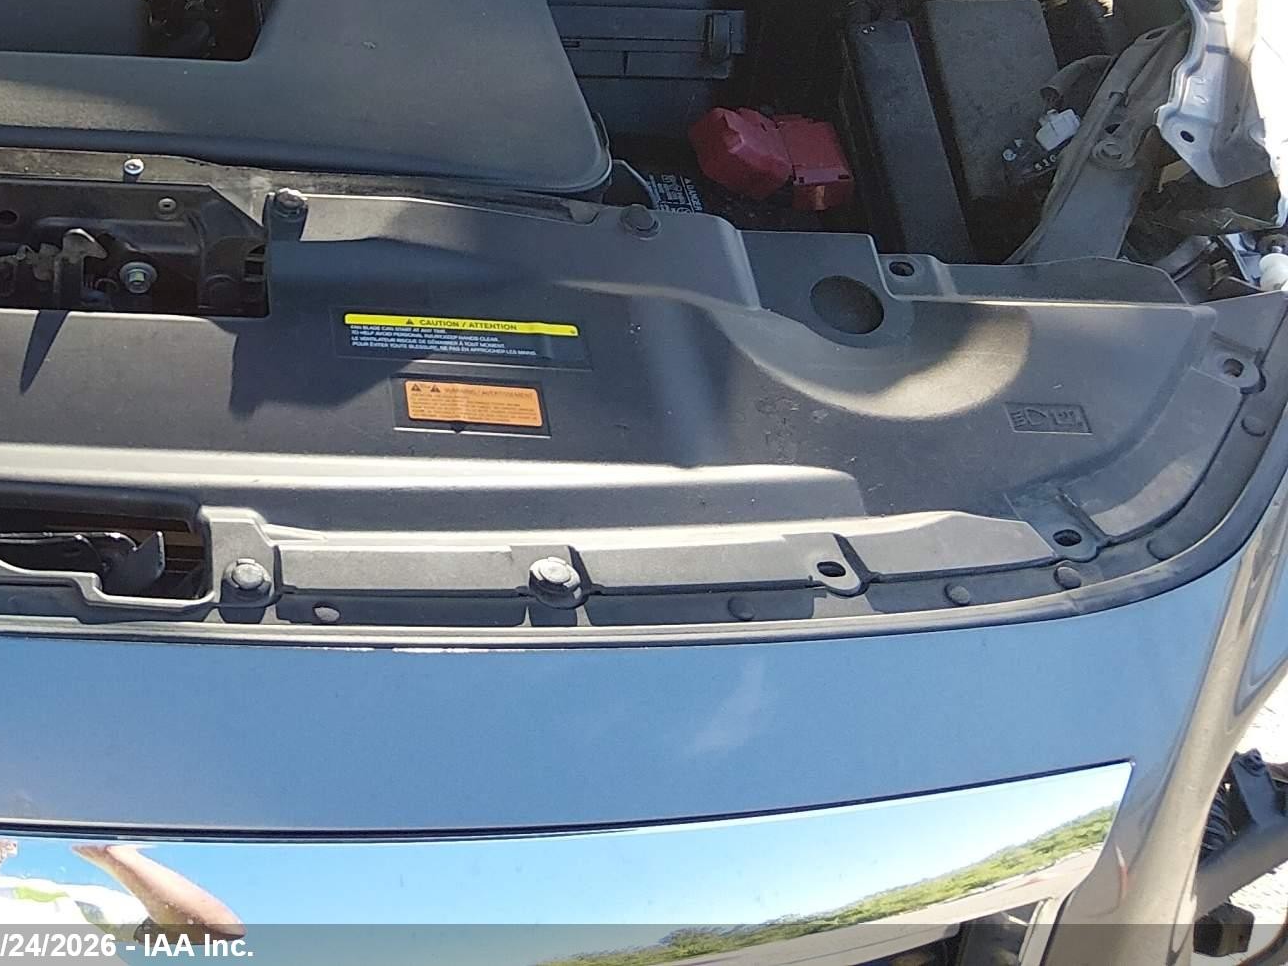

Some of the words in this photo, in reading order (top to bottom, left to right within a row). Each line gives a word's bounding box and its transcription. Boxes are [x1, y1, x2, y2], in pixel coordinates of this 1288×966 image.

[686, 184, 703, 211] DANGER
[419, 319, 460, 328] CAUTION
[468, 321, 518, 331] ATTENTION
